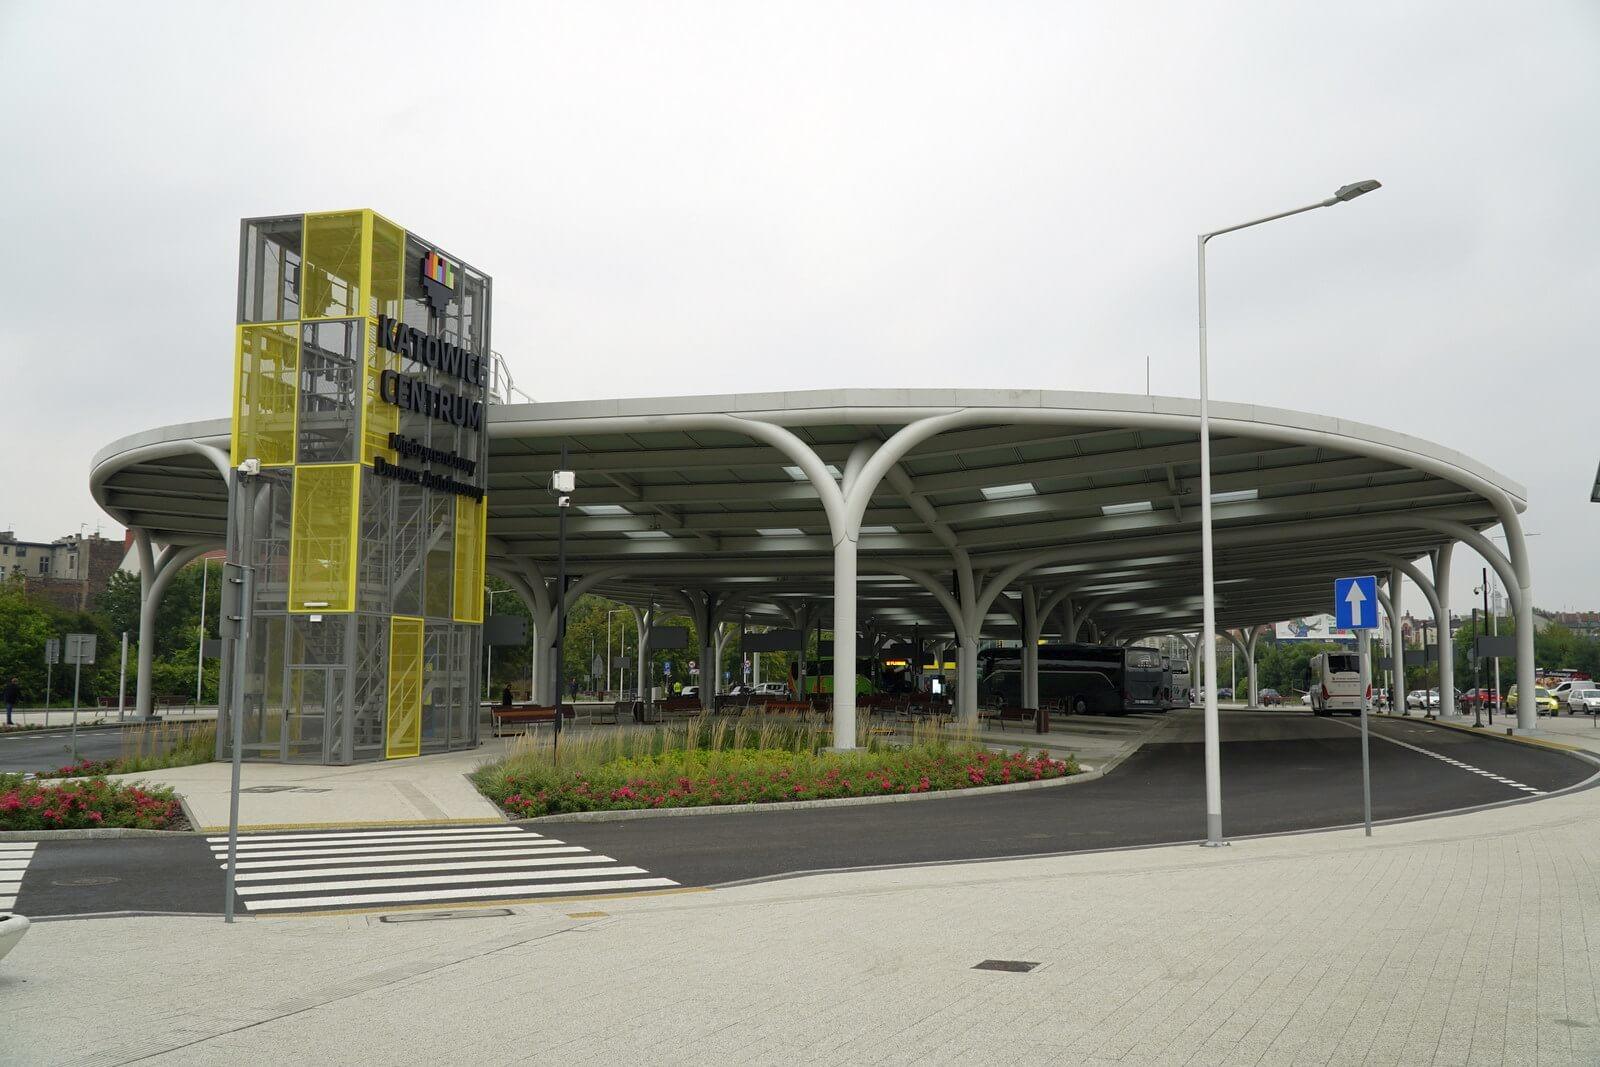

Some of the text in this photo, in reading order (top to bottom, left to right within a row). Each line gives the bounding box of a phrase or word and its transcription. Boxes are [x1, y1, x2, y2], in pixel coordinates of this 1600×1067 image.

[378, 315, 488, 388] KATOWICE
[380, 370, 482, 431] CENTRUM
[374, 456, 484, 504] Dworzec Autobusowy
[388, 432, 476, 476] Międzynarodowy
